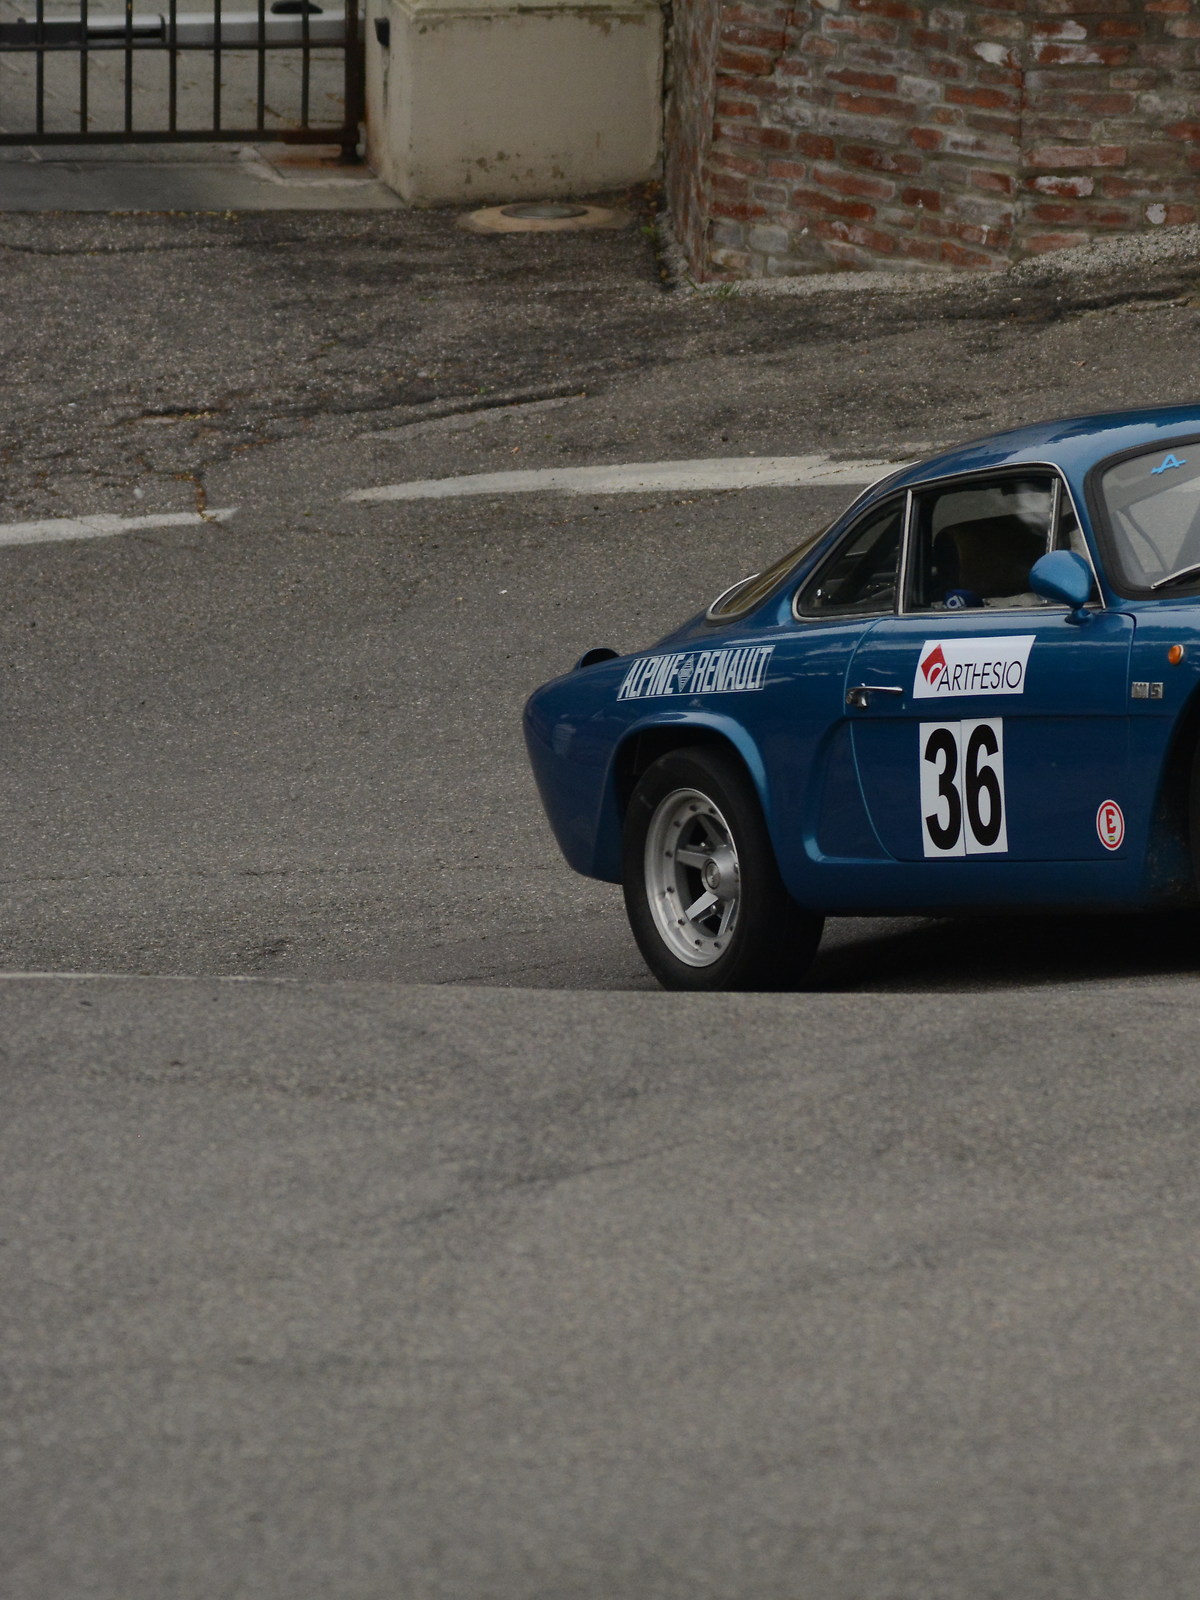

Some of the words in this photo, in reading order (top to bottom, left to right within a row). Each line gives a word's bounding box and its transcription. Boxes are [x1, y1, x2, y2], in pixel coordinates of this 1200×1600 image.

[618, 654, 686, 699] ALPINE
[690, 648, 774, 693] RENAULT
[925, 724, 1002, 850] 36
[1105, 808, 1117, 834] E
